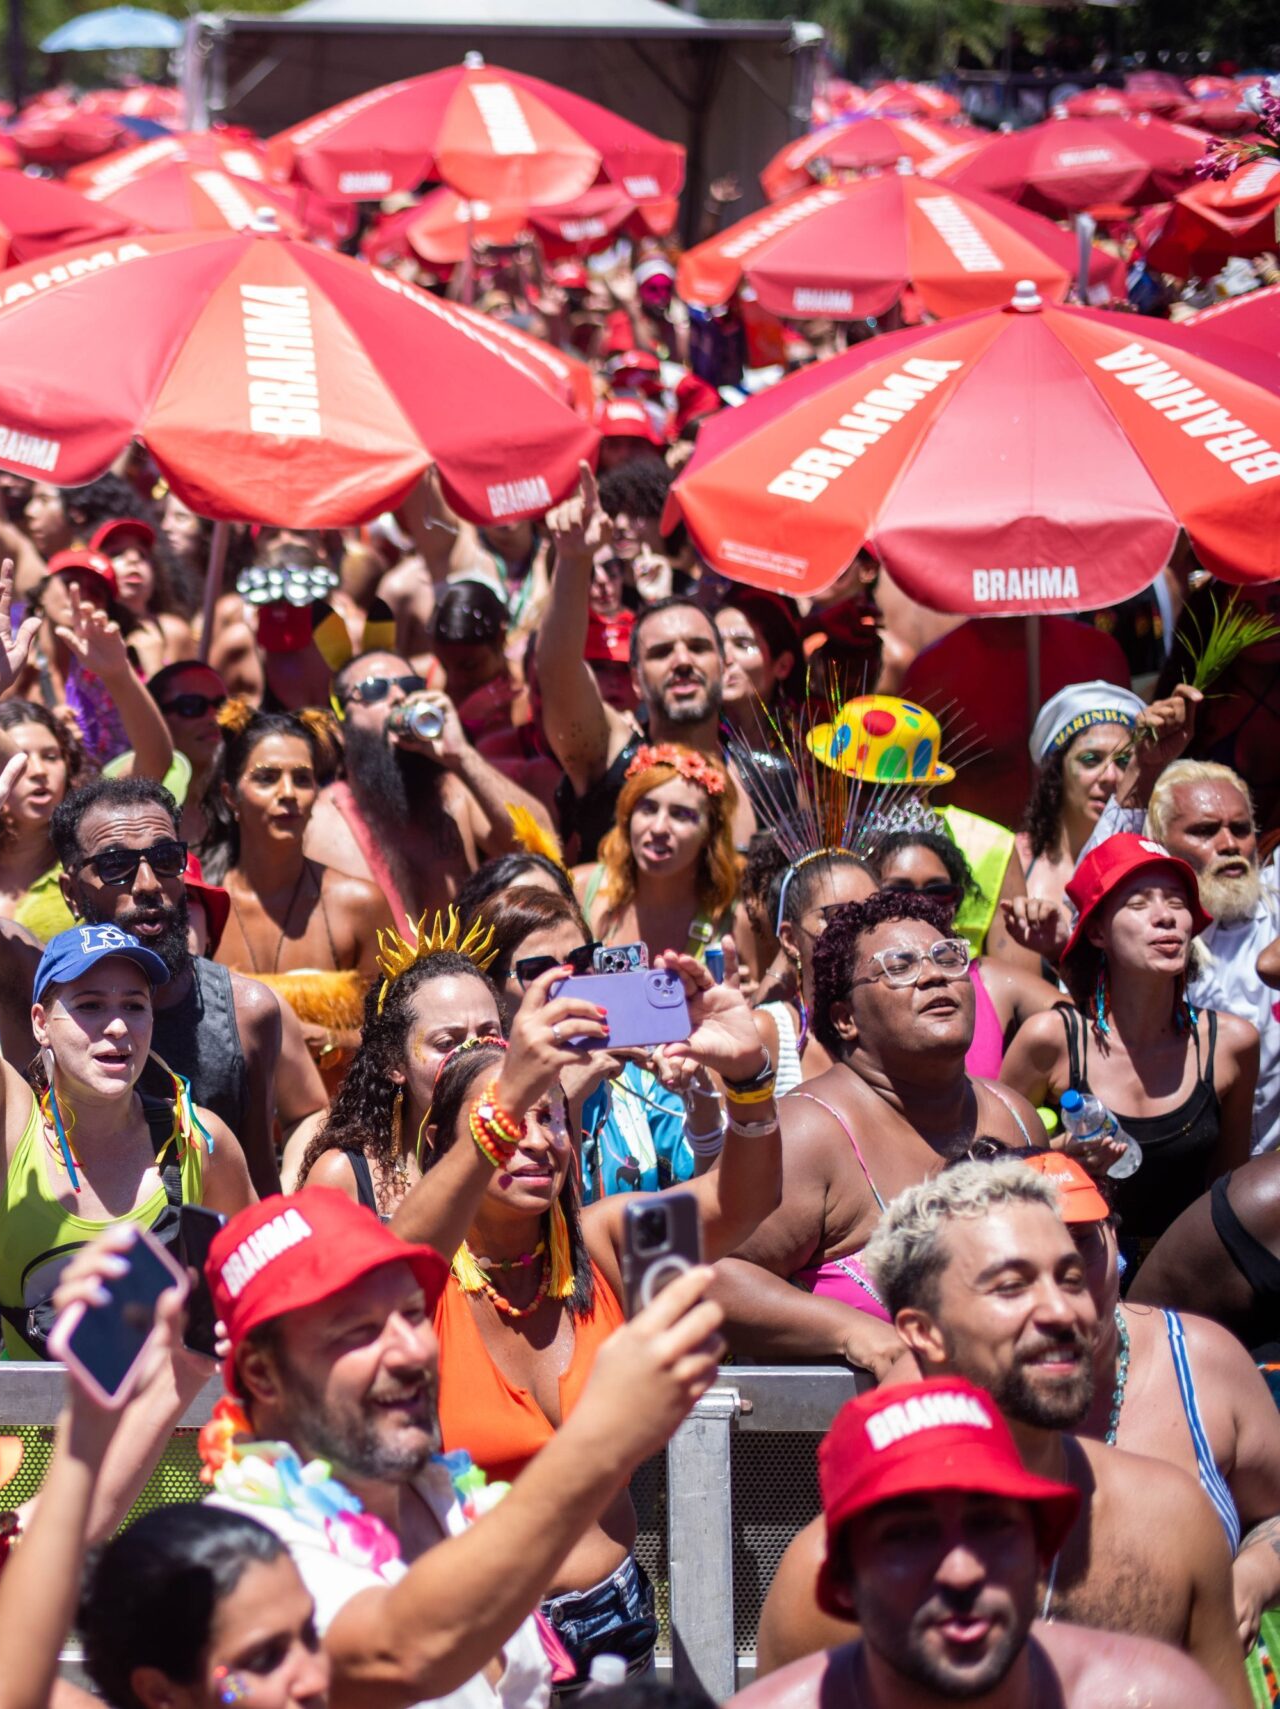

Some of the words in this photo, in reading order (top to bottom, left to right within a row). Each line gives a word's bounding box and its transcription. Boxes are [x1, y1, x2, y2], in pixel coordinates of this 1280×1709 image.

[240, 284, 320, 436] BRAHMA
[766, 357, 964, 503] BRAHMA
[1094, 342, 1280, 485] BRAHMA
[487, 475, 553, 518] BRAHMA
[972, 565, 1080, 602] BRAHMA
[221, 1208, 313, 1298] BRAHMA
[864, 1390, 993, 1452] BRAHMA
